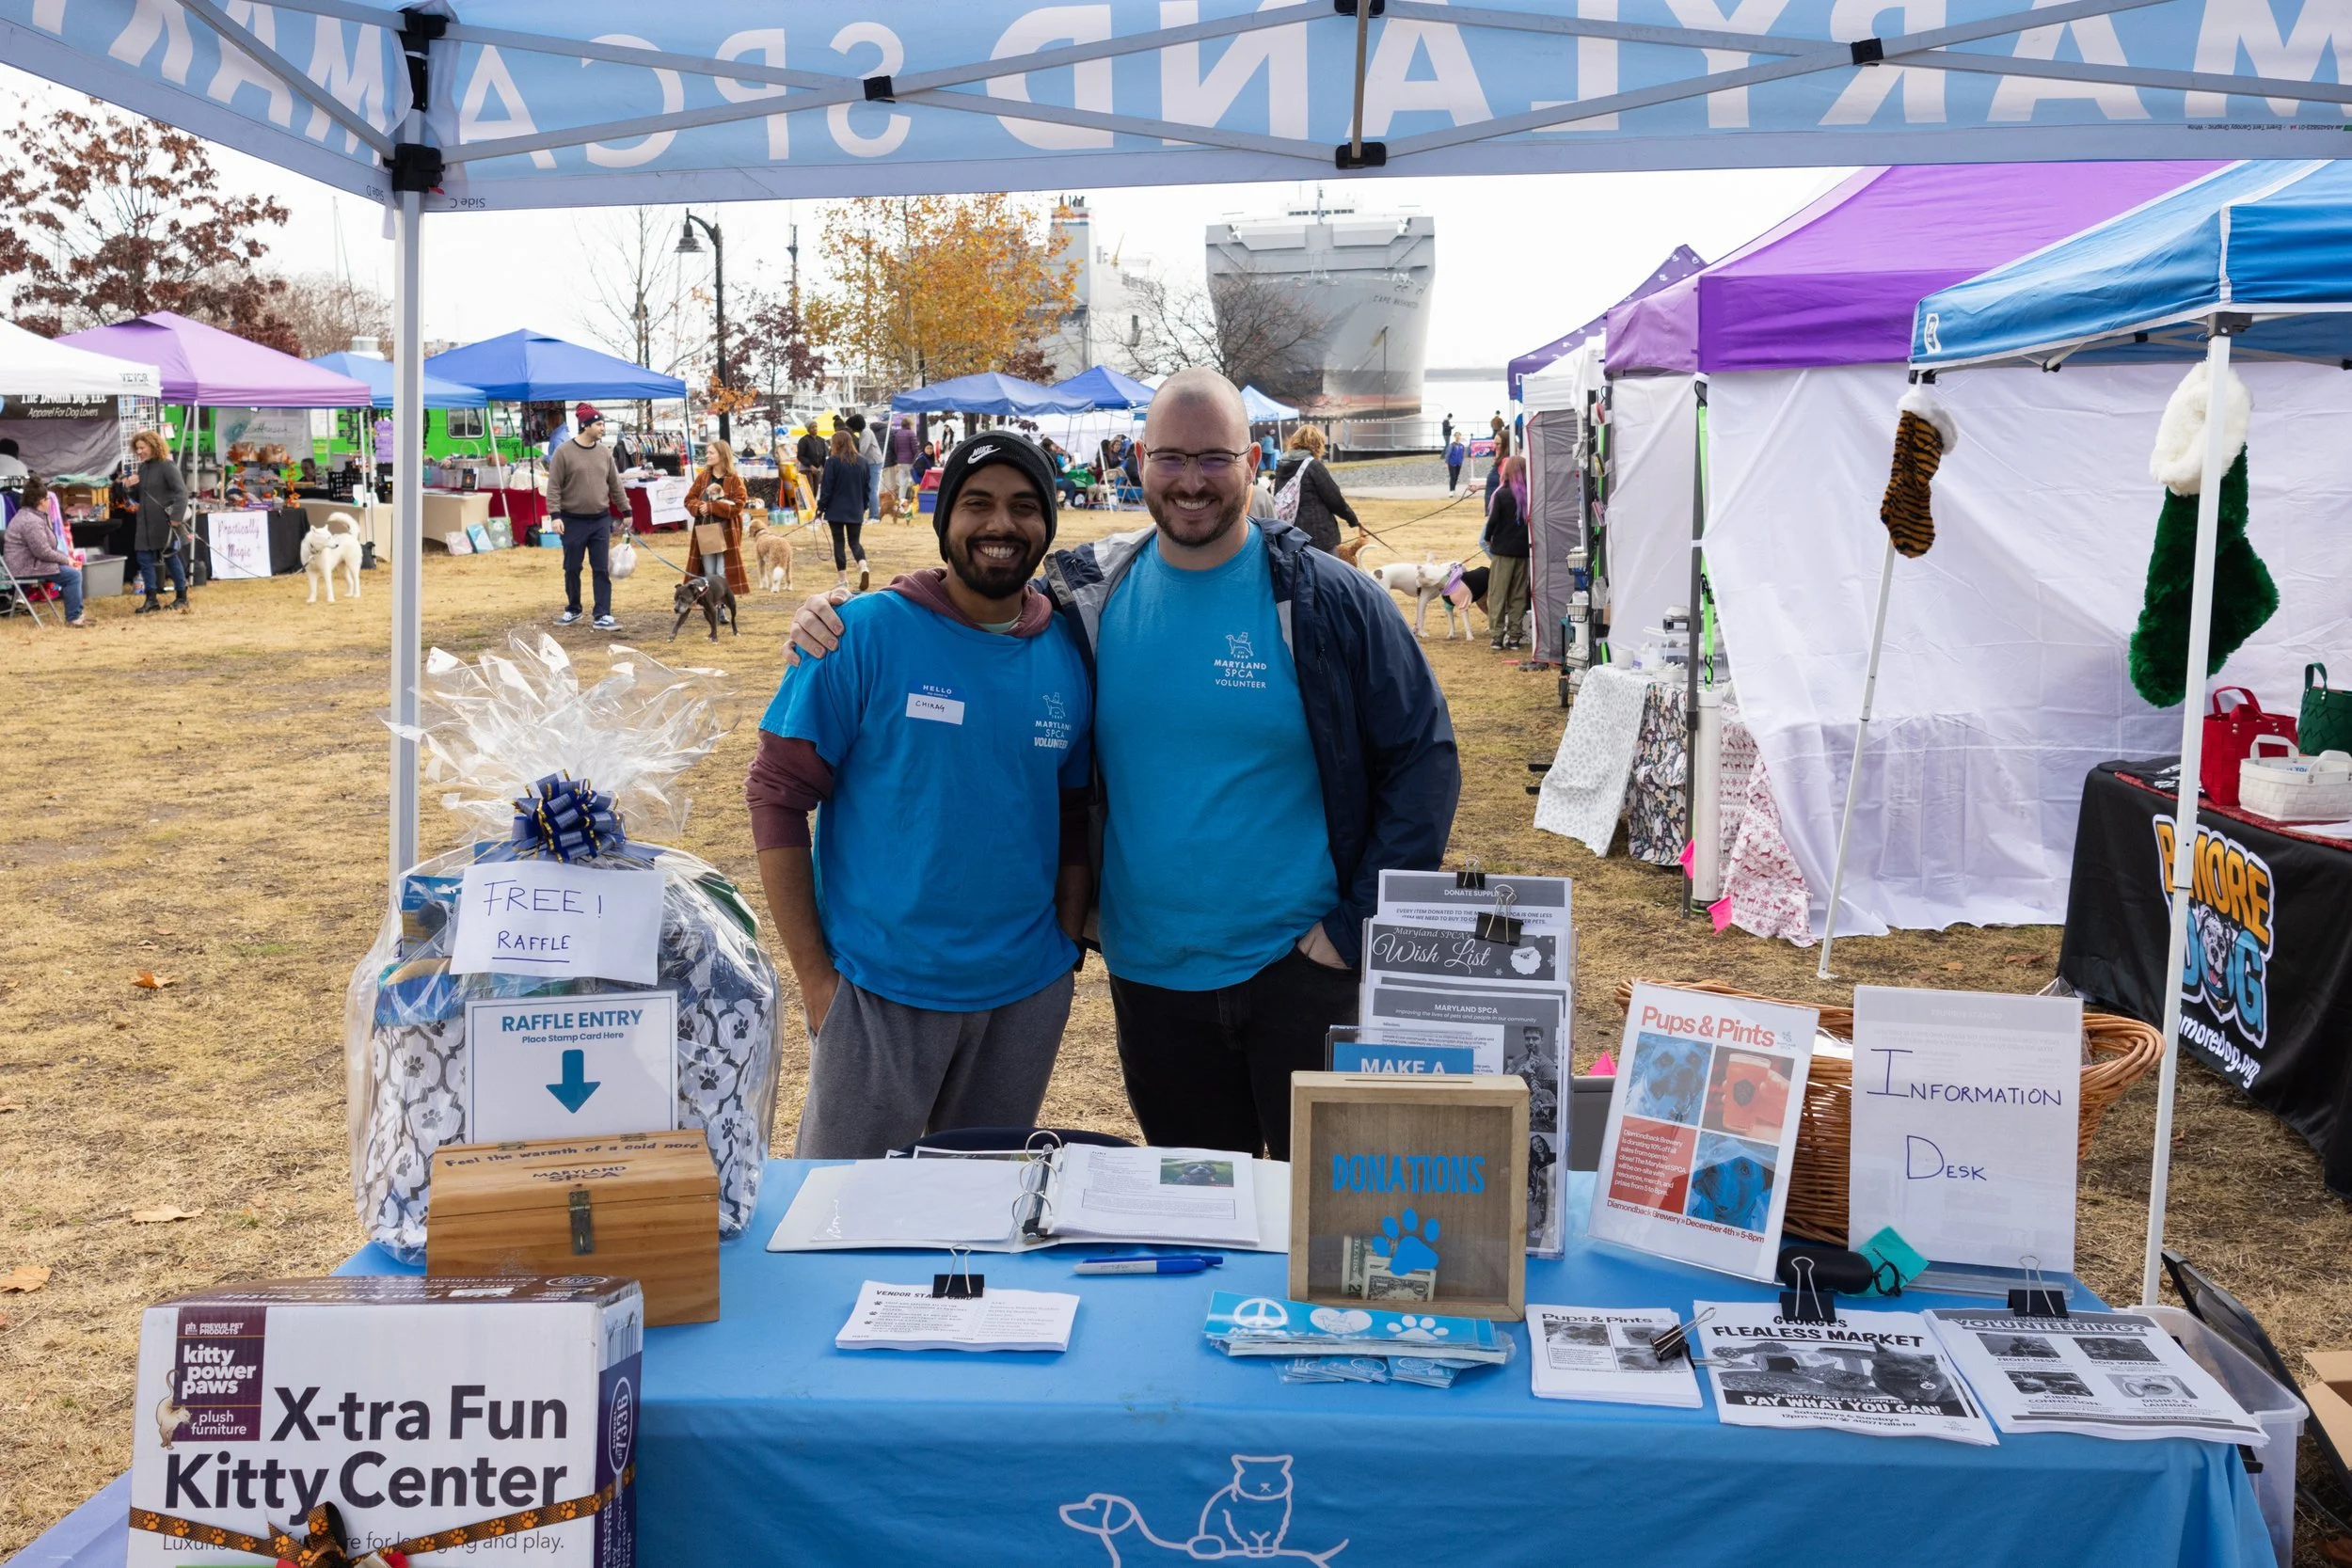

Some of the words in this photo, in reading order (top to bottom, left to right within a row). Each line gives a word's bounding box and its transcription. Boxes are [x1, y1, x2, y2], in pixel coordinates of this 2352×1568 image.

[366, 185, 372, 197] D
[373, 187, 385, 201] Side
[450, 198, 458, 209] C
[460, 198, 486, 209] Side
[27, 407, 56, 420] Apparel
[55, 407, 65, 417] For
[65, 407, 80, 420] Dog
[80, 407, 99, 418] Lovers
[972, 445, 993, 456] NIKE
[216, 518, 260, 539] Practically
[227, 543, 251, 558] Magic
[1214, 659, 1267, 670] MARYLAND
[1225, 668, 1254, 678] SPCA
[922, 685, 952, 695] HELLO
[1215, 678, 1267, 689] VOLUNTEER
[915, 700, 946, 713] CHIRAG
[1045, 729, 1065, 738] SPCA
[1444, 889, 1473, 897] DONATE
[498, 930, 571, 950] RAFFLE
[1393, 927, 1438, 939] Maryland
[1373, 933, 1439, 964] Wish
[1444, 938, 1492, 975] List
[1434, 1004, 1476, 1013] MARYLAND
[501, 1012, 574, 1033] RAFFLE
[578, 1008, 644, 1028] ENTRY
[1507, 1016, 1537, 1024] community
[1641, 1005, 1696, 1035] Pups
[1698, 1015, 1714, 1037] &
[1716, 1017, 1775, 1047] Pints
[522, 1035, 548, 1044] Place
[548, 1033, 579, 1044] Stamp
[580, 1032, 602, 1040] Card
[603, 1031, 624, 1039] Here
[1360, 1058, 1425, 1074] MAKE
[1433, 1061, 1446, 1074] A
[1867, 1048, 2062, 1106] INFORMATION
[1623, 1129, 1661, 1143] Diamondback
[1661, 1136, 1684, 1148] Brewery
[1627, 1138, 1651, 1149] donating
[445, 1157, 481, 1167] Feel
[486, 1152, 513, 1163] the
[519, 1146, 578, 1159] warmth
[584, 1144, 602, 1153] of
[625, 1142, 657, 1151] cold
[662, 1141, 700, 1149] nose
[1620, 1146, 1634, 1154] sales
[1634, 1148, 1647, 1156] from
[1647, 1150, 1660, 1160] open
[1906, 1134, 1987, 1181] DESK
[1634, 1156, 1645, 1164] The
[1645, 1159, 1670, 1171] Maryland
[532, 1165, 628, 1178] MARYLAND
[548, 1170, 622, 1182] SPCA
[1332, 1153, 1486, 1195] DONATIONS
[1614, 1179, 1630, 1188] prizes
[1630, 1181, 1645, 1190] from
[1662, 1180, 1674, 1189] and
[1607, 1199, 1652, 1217] Diamondback
[1652, 1209, 1681, 1225] Brewery
[1685, 1218, 1723, 1233] December
[1723, 1227, 1735, 1237] 4th
[1740, 1231, 1765, 1243] 5-8pm
[876, 1290, 912, 1298] VENDOR
[1542, 1313, 1588, 1323] Pups
[1591, 1315, 1603, 1323] &
[1606, 1316, 1653, 1324] Pints
[1950, 1318, 2147, 1333] VOLUNTEERING?
[1711, 1326, 1822, 1340] FLEALESS
[1827, 1331, 1925, 1348] MARKET
[183, 1344, 235, 1366] kitty
[187, 1364, 257, 1383] power
[181, 1379, 239, 1400] paws
[1743, 1396, 1781, 1407] PAY
[1786, 1398, 1838, 1410] WHAT
[1844, 1401, 1890, 1414] YOU
[1895, 1404, 1944, 1416] CAN!
[199, 1410, 234, 1426] plush
[270, 1386, 430, 1443] X-tra
[449, 1385, 568, 1441] Fun
[1793, 1409, 1846, 1418] Saturdays
[1855, 1414, 1900, 1422] Sundays
[190, 1423, 247, 1435] furniture
[165, 1450, 329, 1527] Kitty
[340, 1450, 568, 1509] Center
[366, 1533, 390, 1550] for
[483, 1533, 517, 1550] and
[521, 1533, 565, 1556] play.
